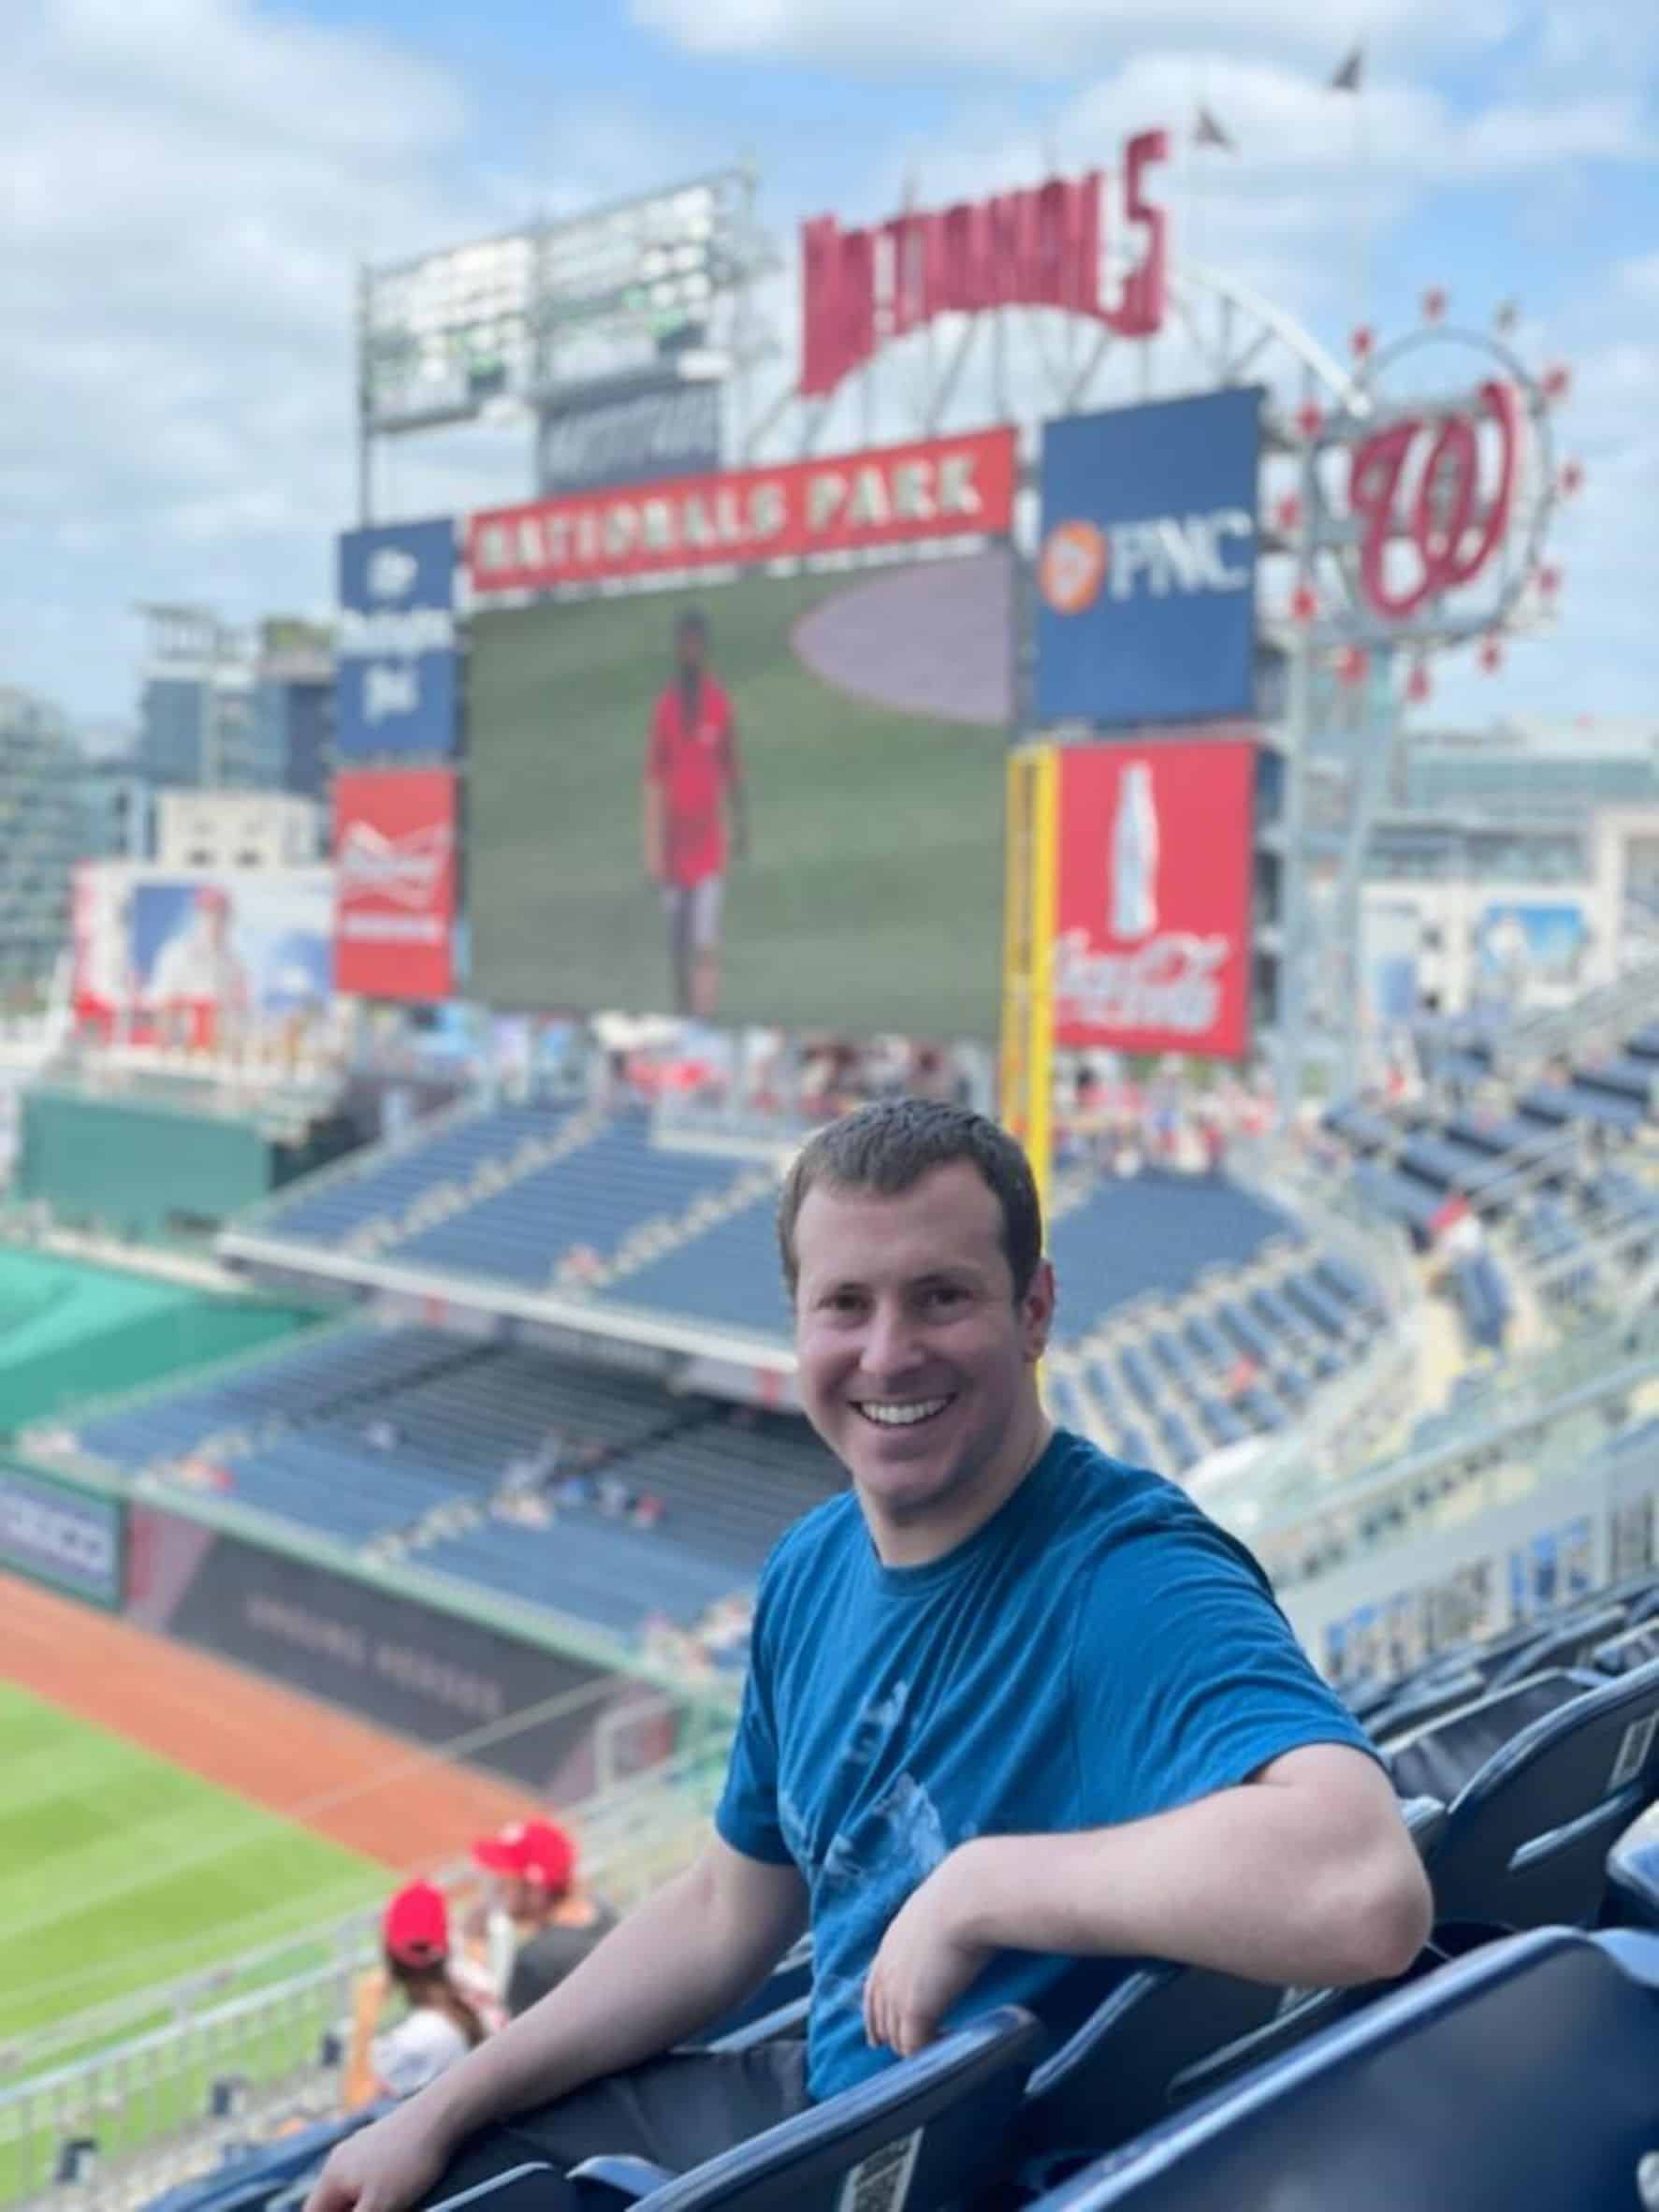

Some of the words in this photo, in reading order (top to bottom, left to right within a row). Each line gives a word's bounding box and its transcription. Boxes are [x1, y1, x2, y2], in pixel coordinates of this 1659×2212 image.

[477, 481, 788, 571] NATIONALS
[807, 453, 982, 533] PARK
[1104, 508, 1252, 600] PNC
